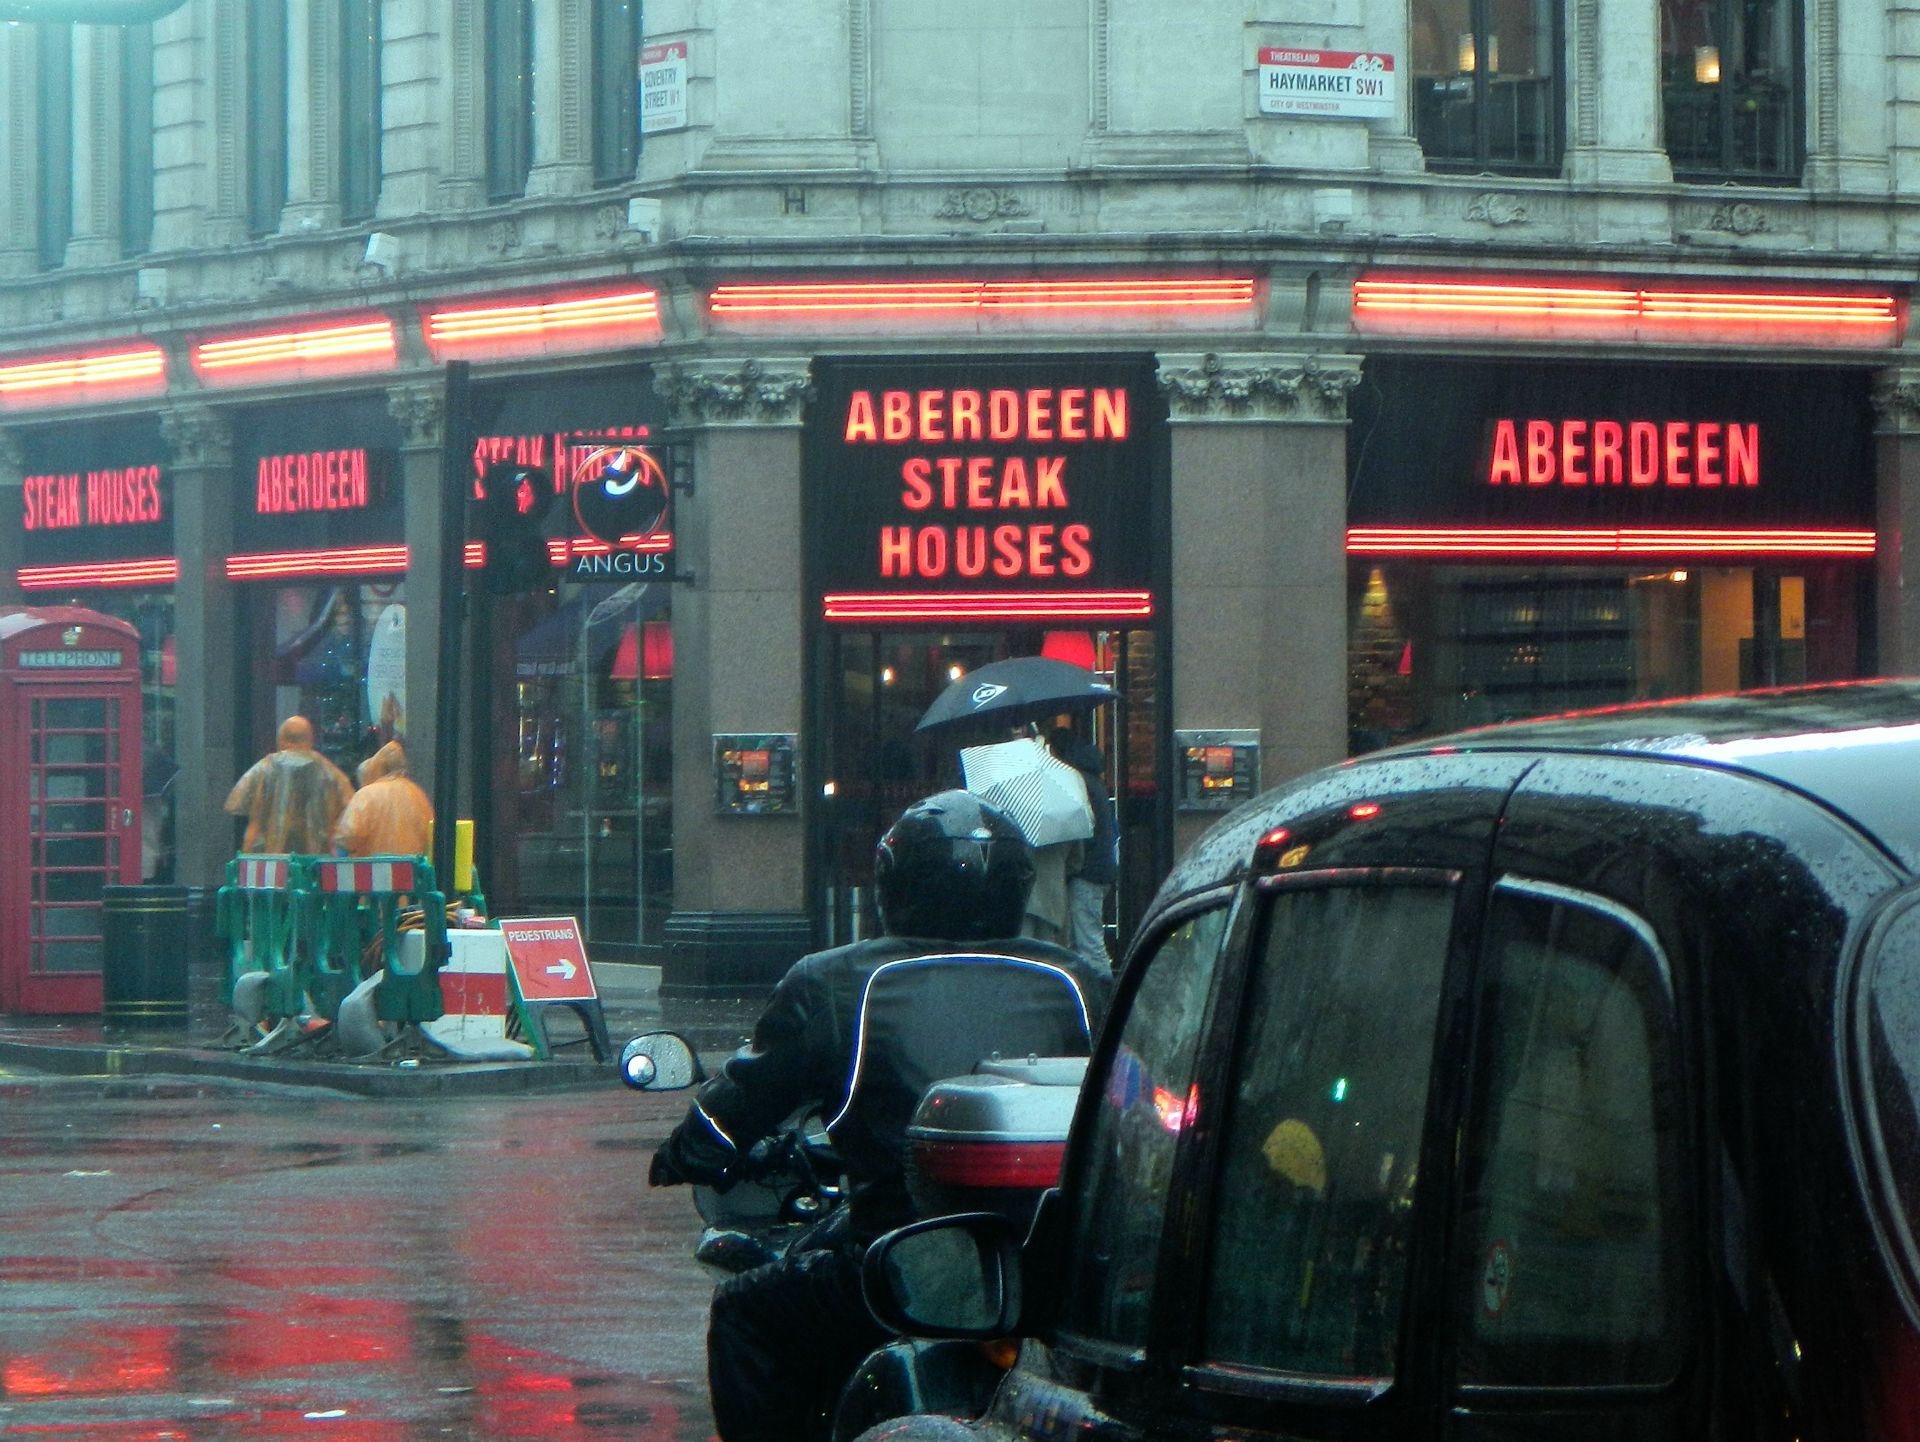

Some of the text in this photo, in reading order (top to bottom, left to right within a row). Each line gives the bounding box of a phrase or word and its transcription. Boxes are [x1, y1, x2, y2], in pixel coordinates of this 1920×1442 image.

[644, 90, 668, 109] STREET
[1270, 72, 1383, 96] HAYMARKET SW1
[845, 387, 1128, 441] ABERDEEN
[1489, 418, 1760, 486] ABERDEEN
[24, 464, 161, 530] STEAK HOUSES
[256, 448, 367, 513] ABERDEEN
[901, 456, 1068, 509] STEAK
[576, 552, 665, 574] ANGUS
[880, 523, 1092, 577] HOUSES
[24, 652, 119, 666] TELEPHONE
[508, 928, 575, 942] PEDESTRIANS
